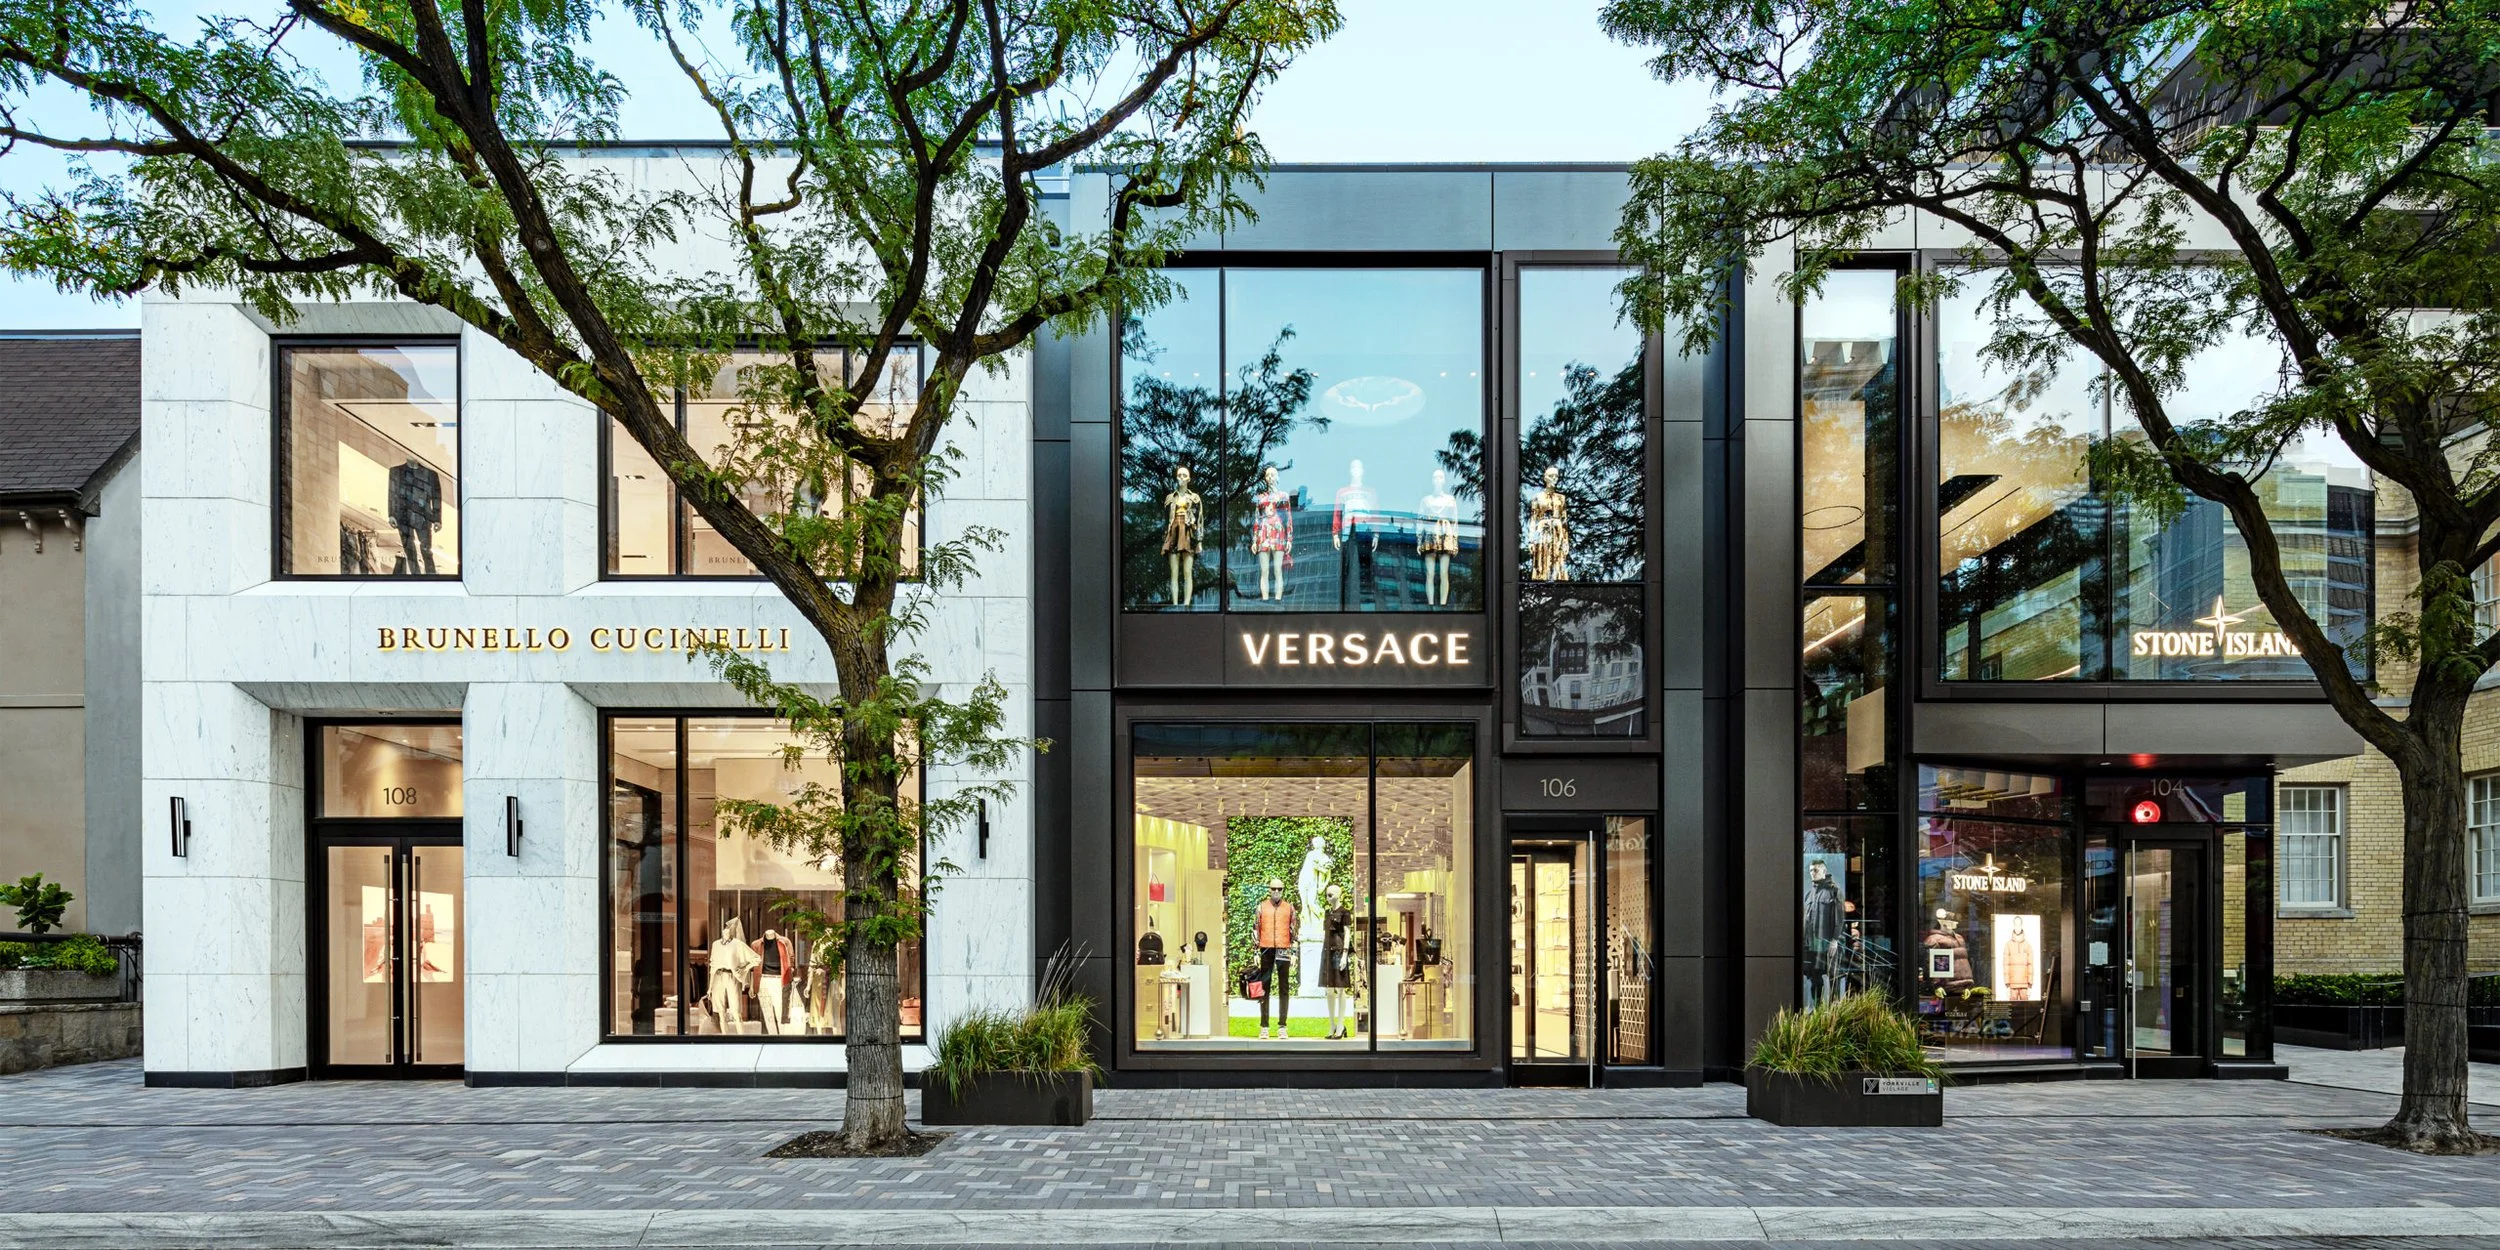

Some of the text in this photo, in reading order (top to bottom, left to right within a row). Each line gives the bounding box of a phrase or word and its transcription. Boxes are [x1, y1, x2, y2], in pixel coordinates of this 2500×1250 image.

[708, 556, 748, 564] BRUNEL
[378, 627, 789, 650] BRUNELLO CUCINELLI
[2133, 631, 2215, 656] STONE
[1242, 632, 1470, 665] VERSACE
[383, 786, 416, 805] 108
[1540, 778, 1576, 797] 106
[2151, 778, 2184, 796] 104
[1952, 875, 2026, 892] STONE ISLAND
